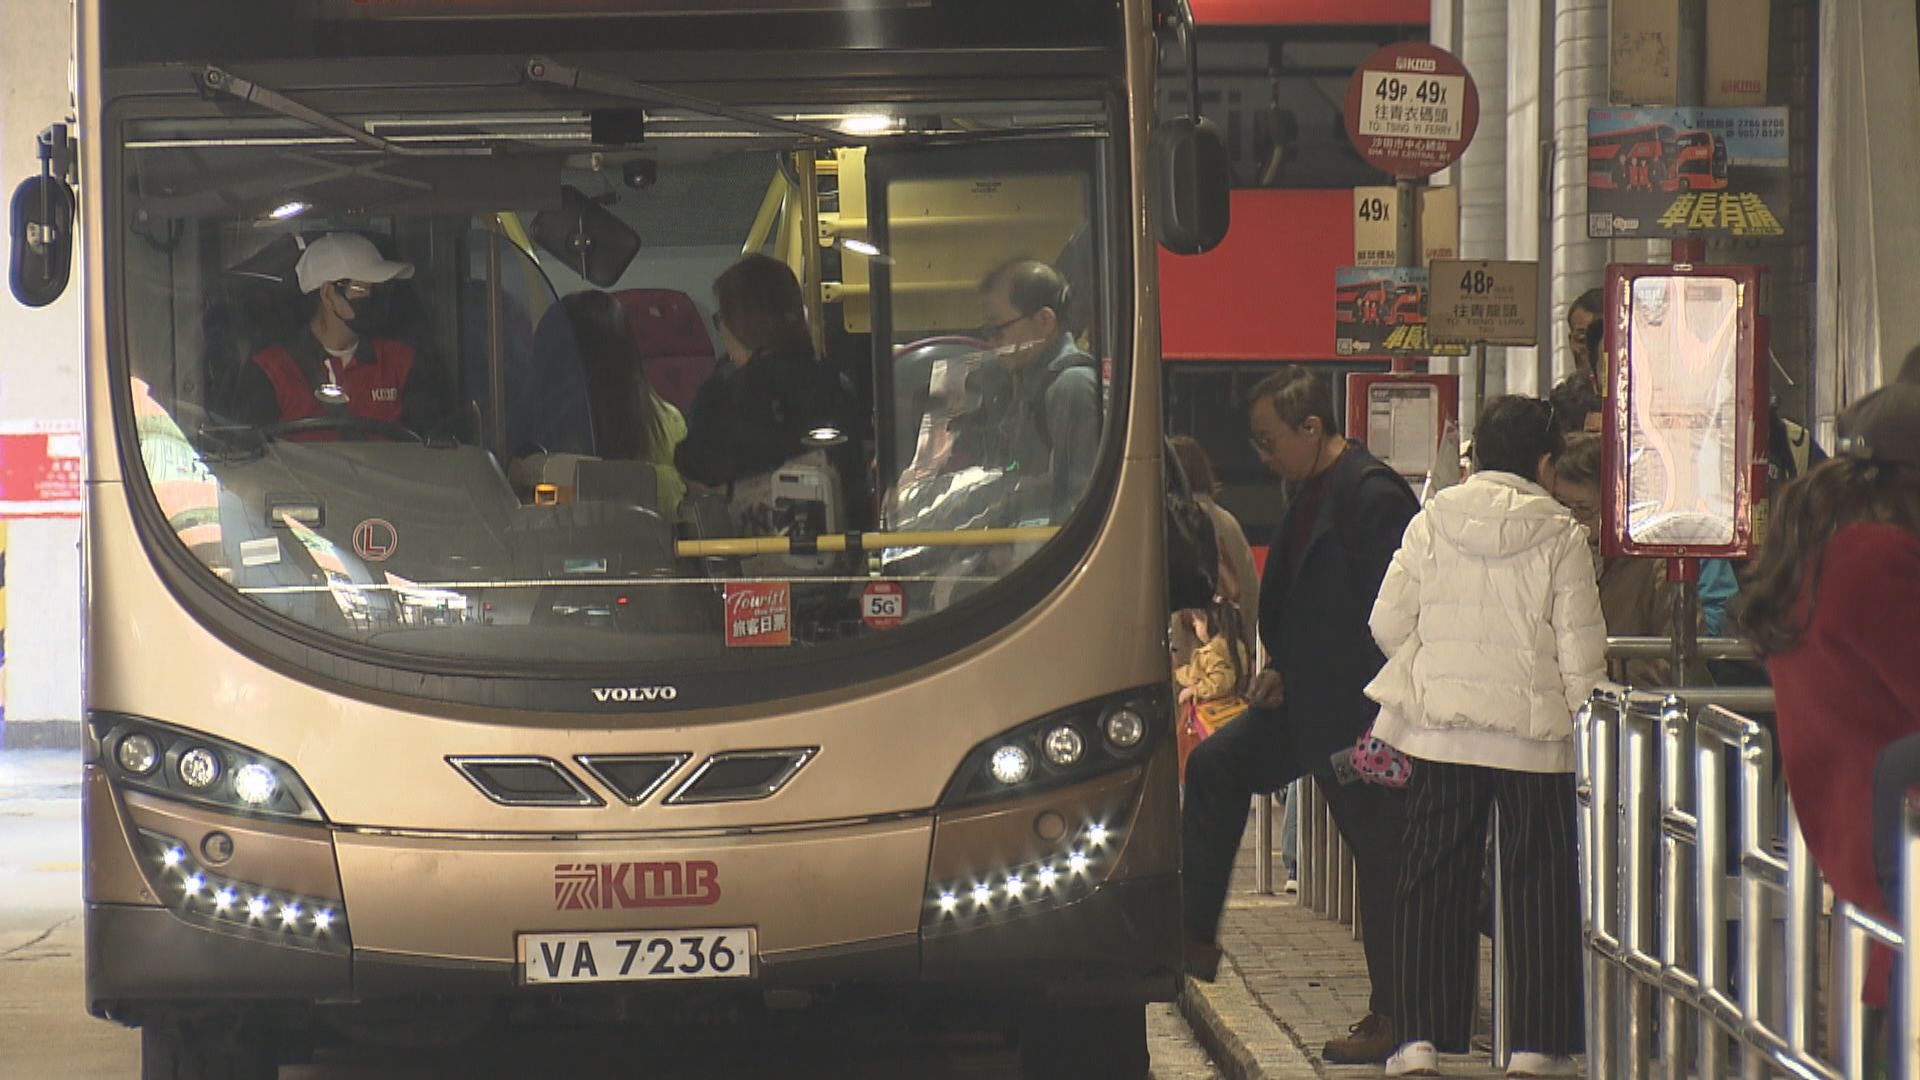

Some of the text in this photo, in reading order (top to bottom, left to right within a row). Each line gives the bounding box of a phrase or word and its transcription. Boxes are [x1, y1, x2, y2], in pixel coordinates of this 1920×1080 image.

[1376, 77, 1447, 105] 49P 49X
[1375, 103, 1448, 124] 往青衣碼頭
[1425, 124, 1452, 135] FERRY
[1359, 198, 1389, 222] 49X
[1656, 191, 1784, 230] 車長有請
[1460, 270, 1494, 295] 48P
[727, 589, 785, 616] Tourist
[591, 686, 677, 701] VOLVO
[601, 860, 721, 909] KMB
[540, 935, 735, 977] VA 7236
